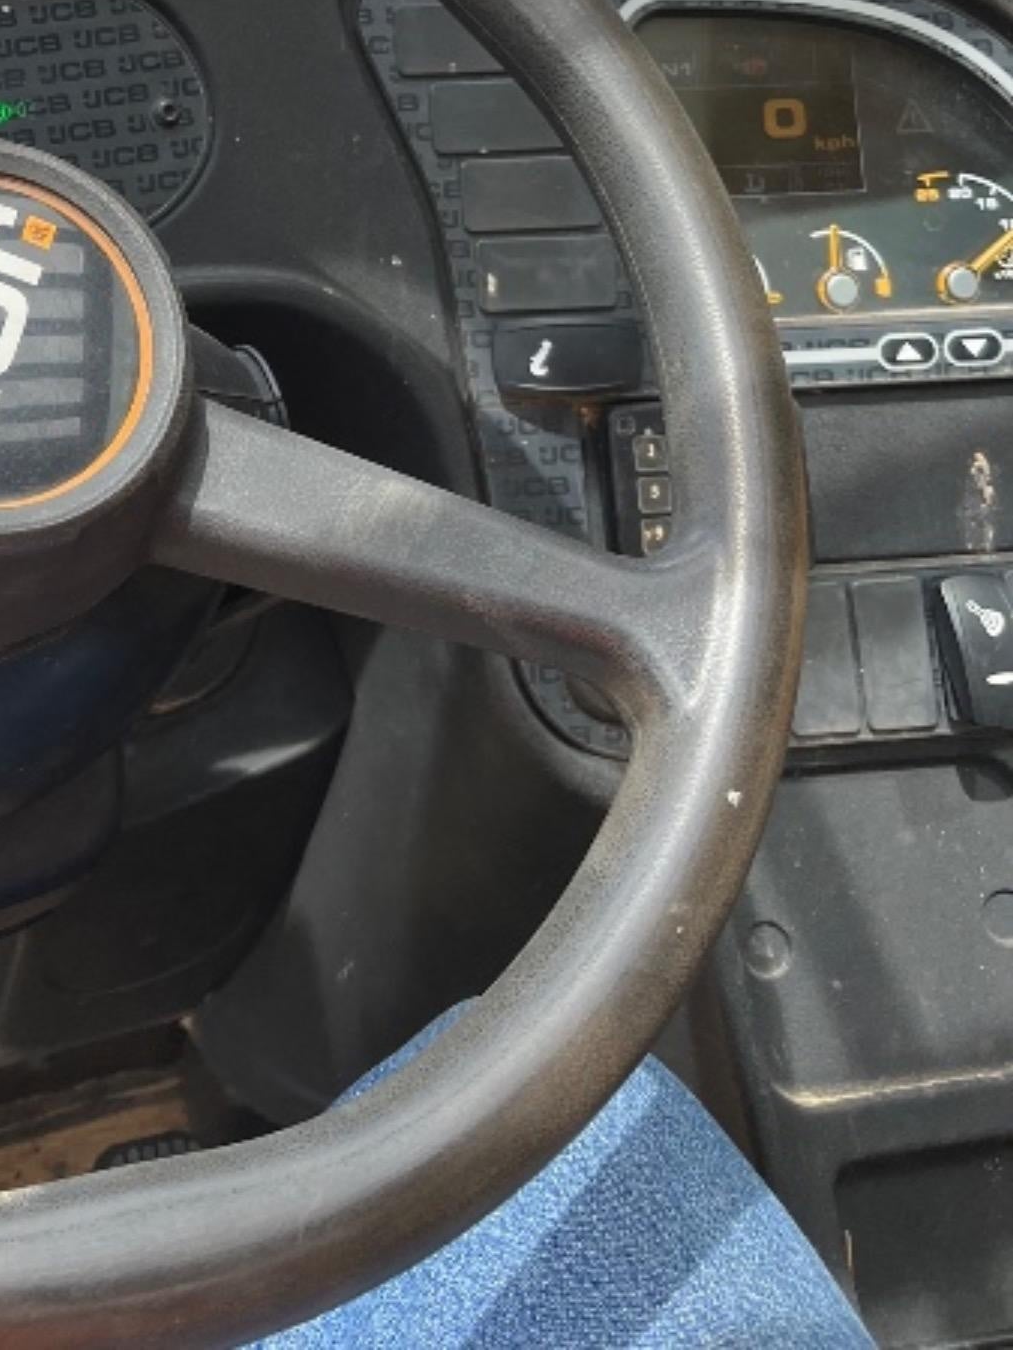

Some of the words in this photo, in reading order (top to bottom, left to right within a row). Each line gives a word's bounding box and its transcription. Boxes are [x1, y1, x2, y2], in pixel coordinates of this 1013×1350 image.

[28, 1, 98, 25] JCB
[72, 24, 141, 49] JCB
[37, 59, 106, 85] JCB
[118, 50, 186, 74] JCB
[82, 84, 149, 110] JCB
[763, 97, 807, 140] 0
[47, 119, 116, 145] JCB
[814, 133, 856, 152] kph
[92, 144, 159, 169] JCB
[135, 170, 192, 194] JC
